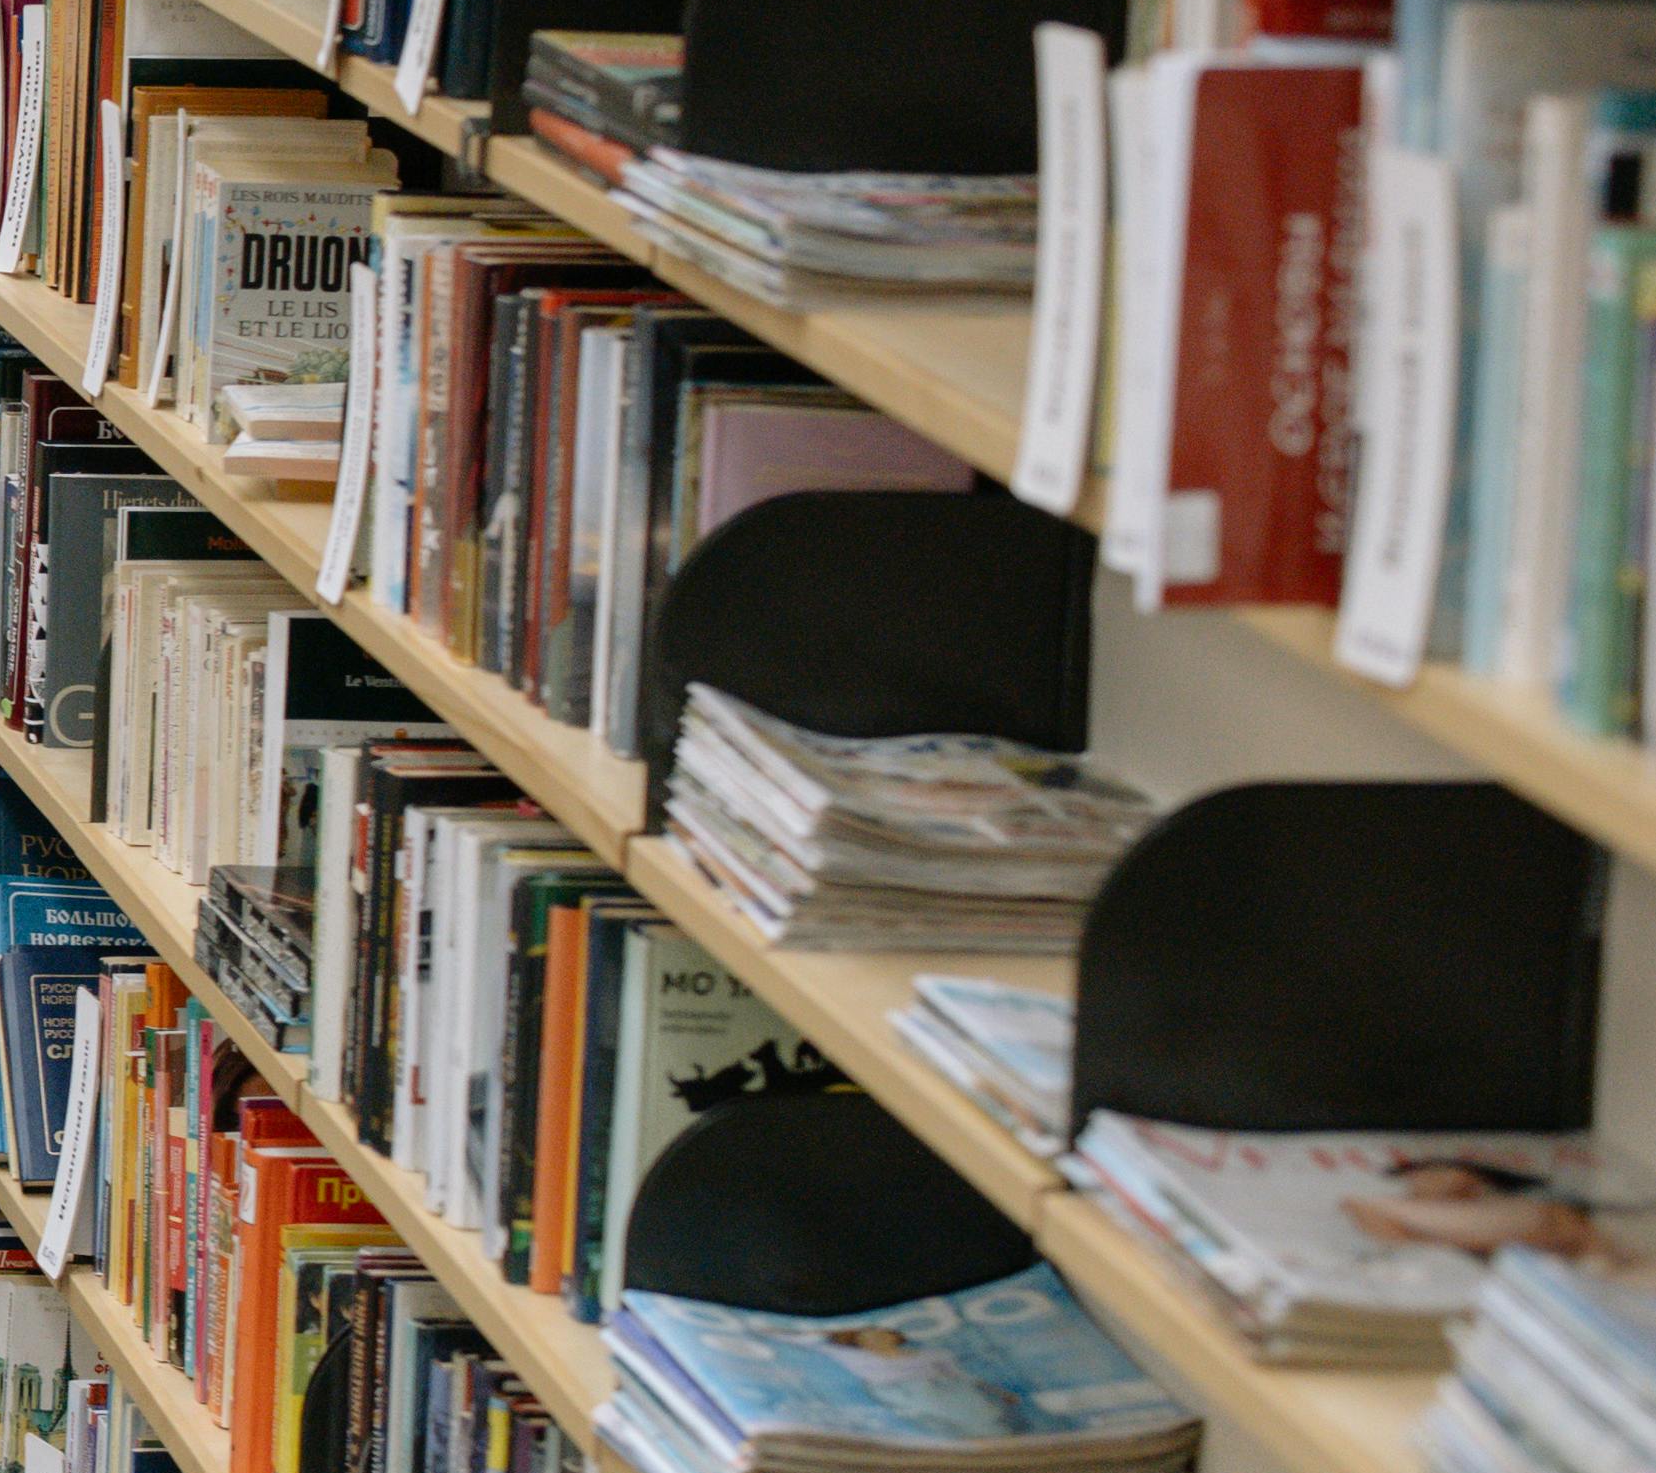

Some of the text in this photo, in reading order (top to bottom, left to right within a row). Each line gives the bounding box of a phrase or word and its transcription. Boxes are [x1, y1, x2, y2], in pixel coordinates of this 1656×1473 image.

[230, 189, 374, 205] LES ROIS MAUDITS
[267, 300, 339, 319] LE LIS
[237, 321, 350, 341] ET LE LIO
[45, 908, 134, 929] БОЛЬШО
[57, 1039, 90, 1221] Испанский язык
